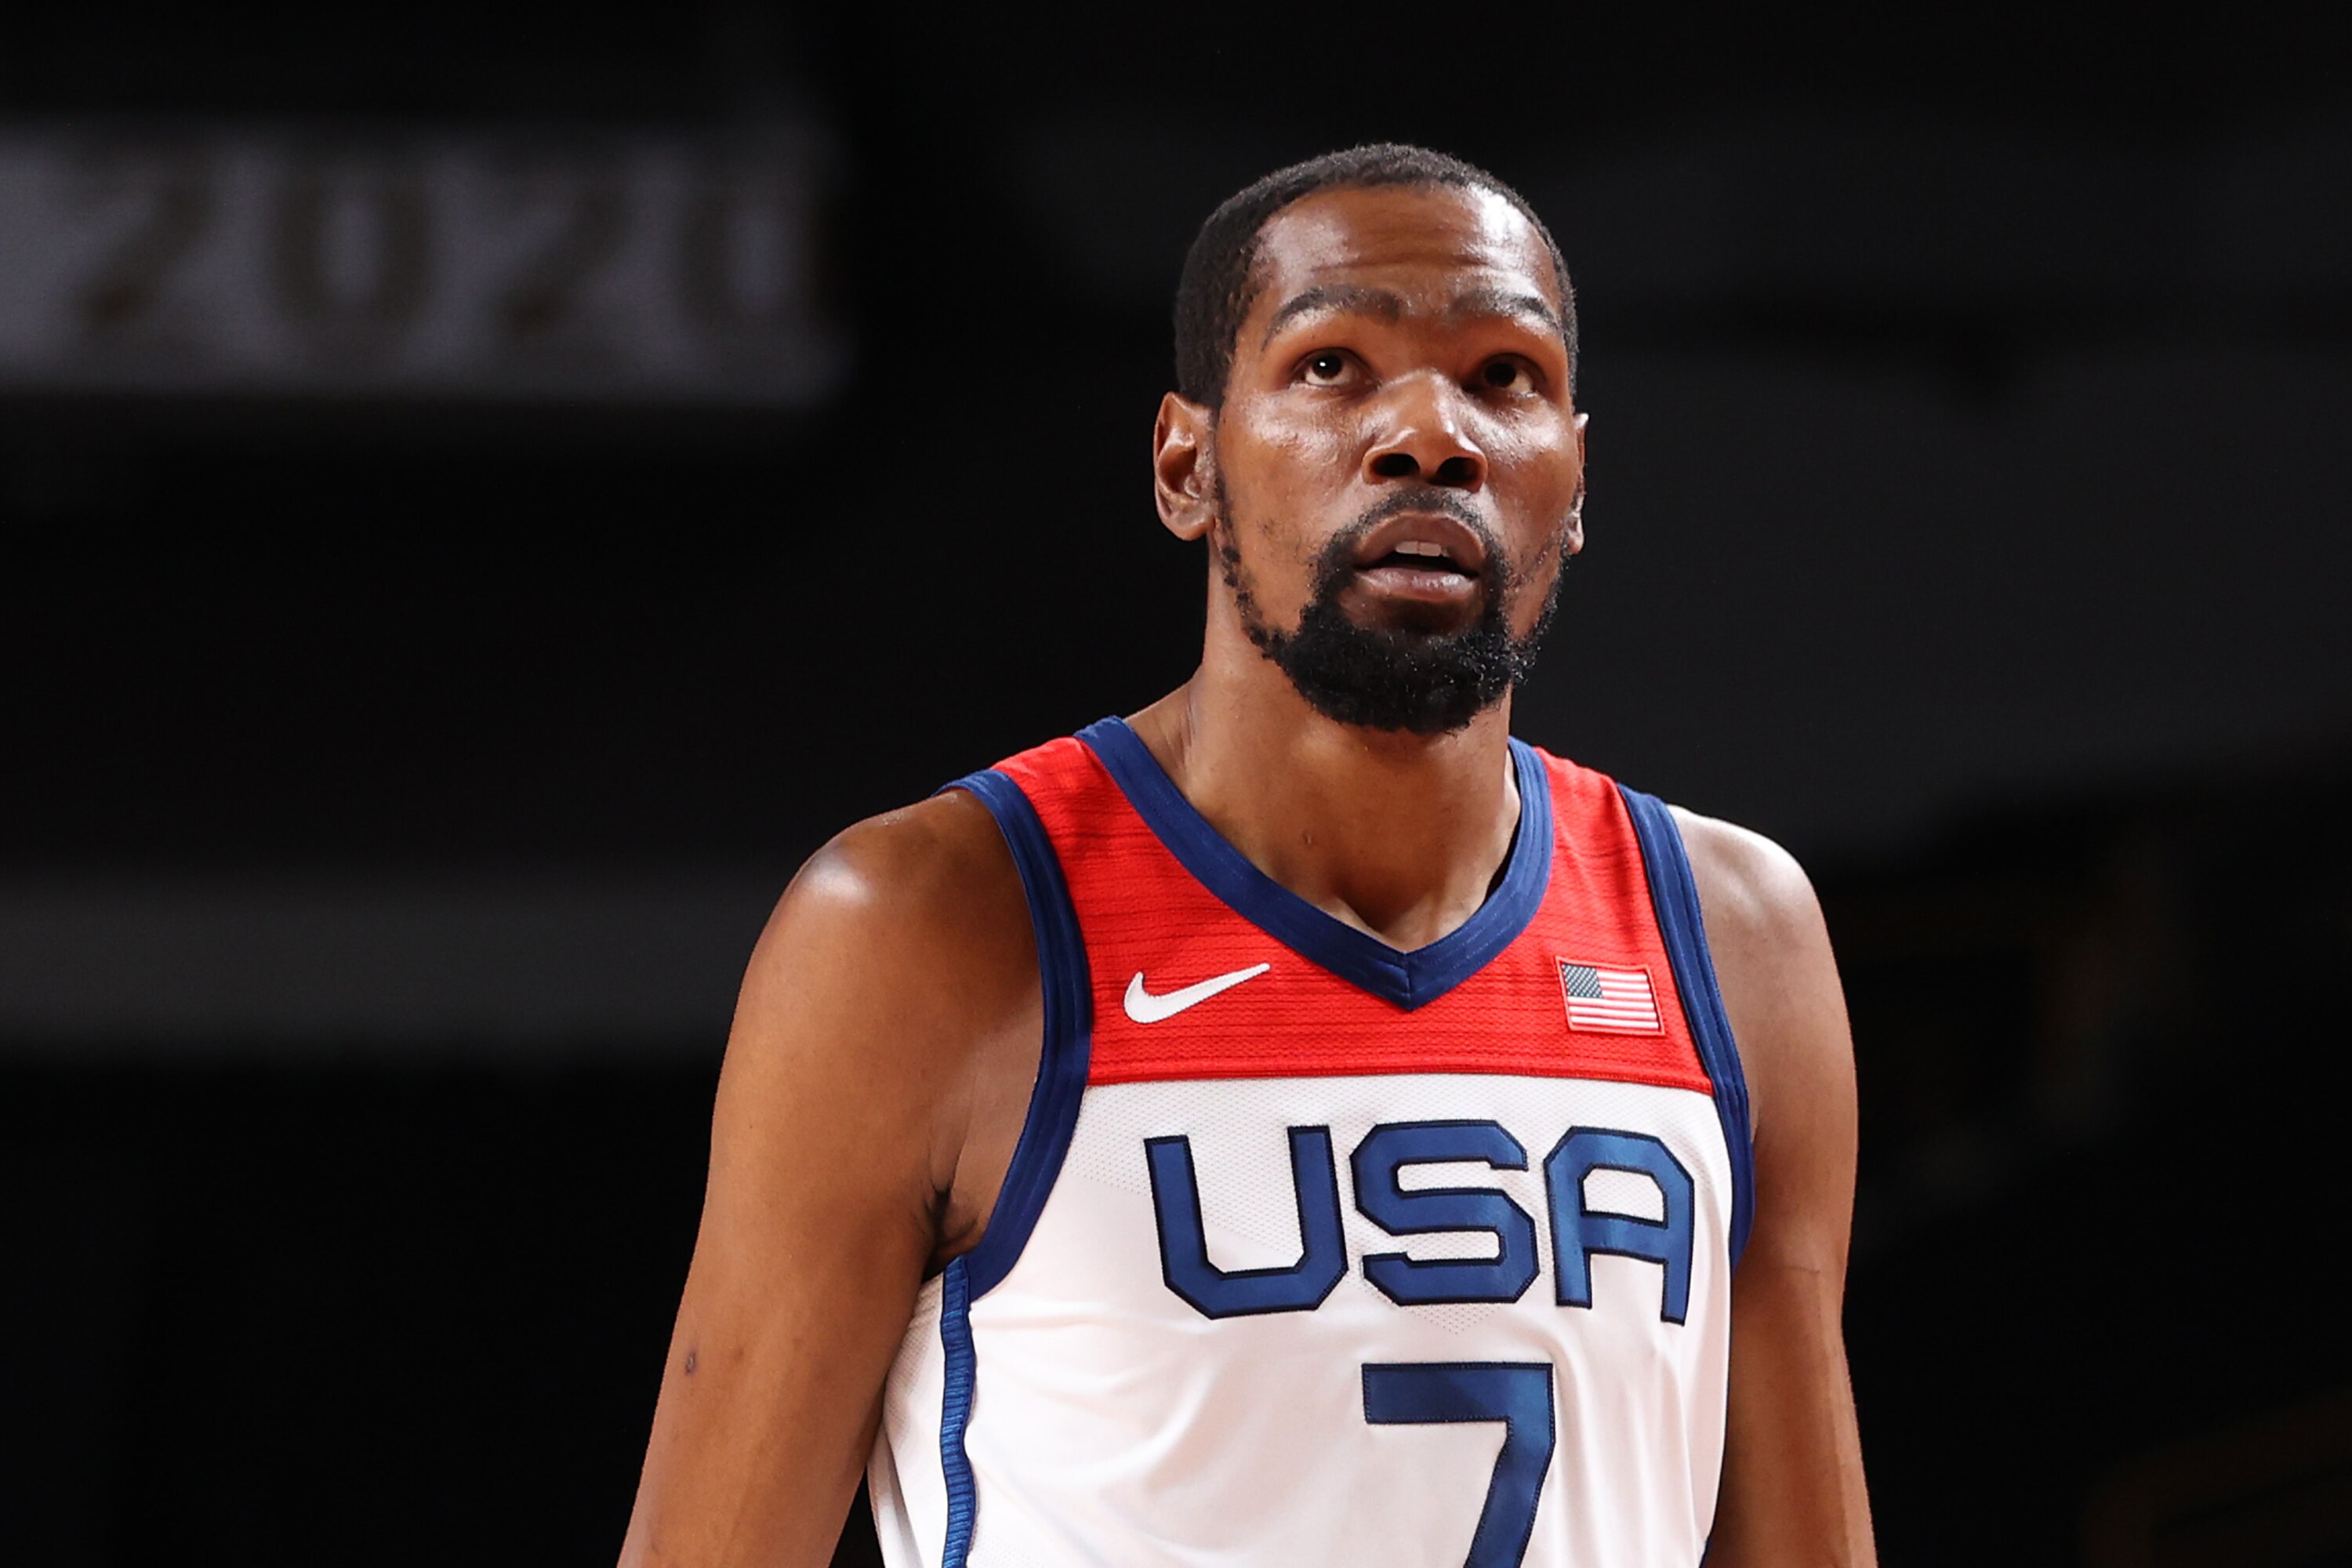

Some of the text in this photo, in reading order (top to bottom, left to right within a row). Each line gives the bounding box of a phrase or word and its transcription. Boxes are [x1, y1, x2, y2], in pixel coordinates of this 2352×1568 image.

[67, 145, 848, 370] 2020
[1144, 1119, 1695, 1327] USA
[1361, 1362, 1556, 1568] 7
